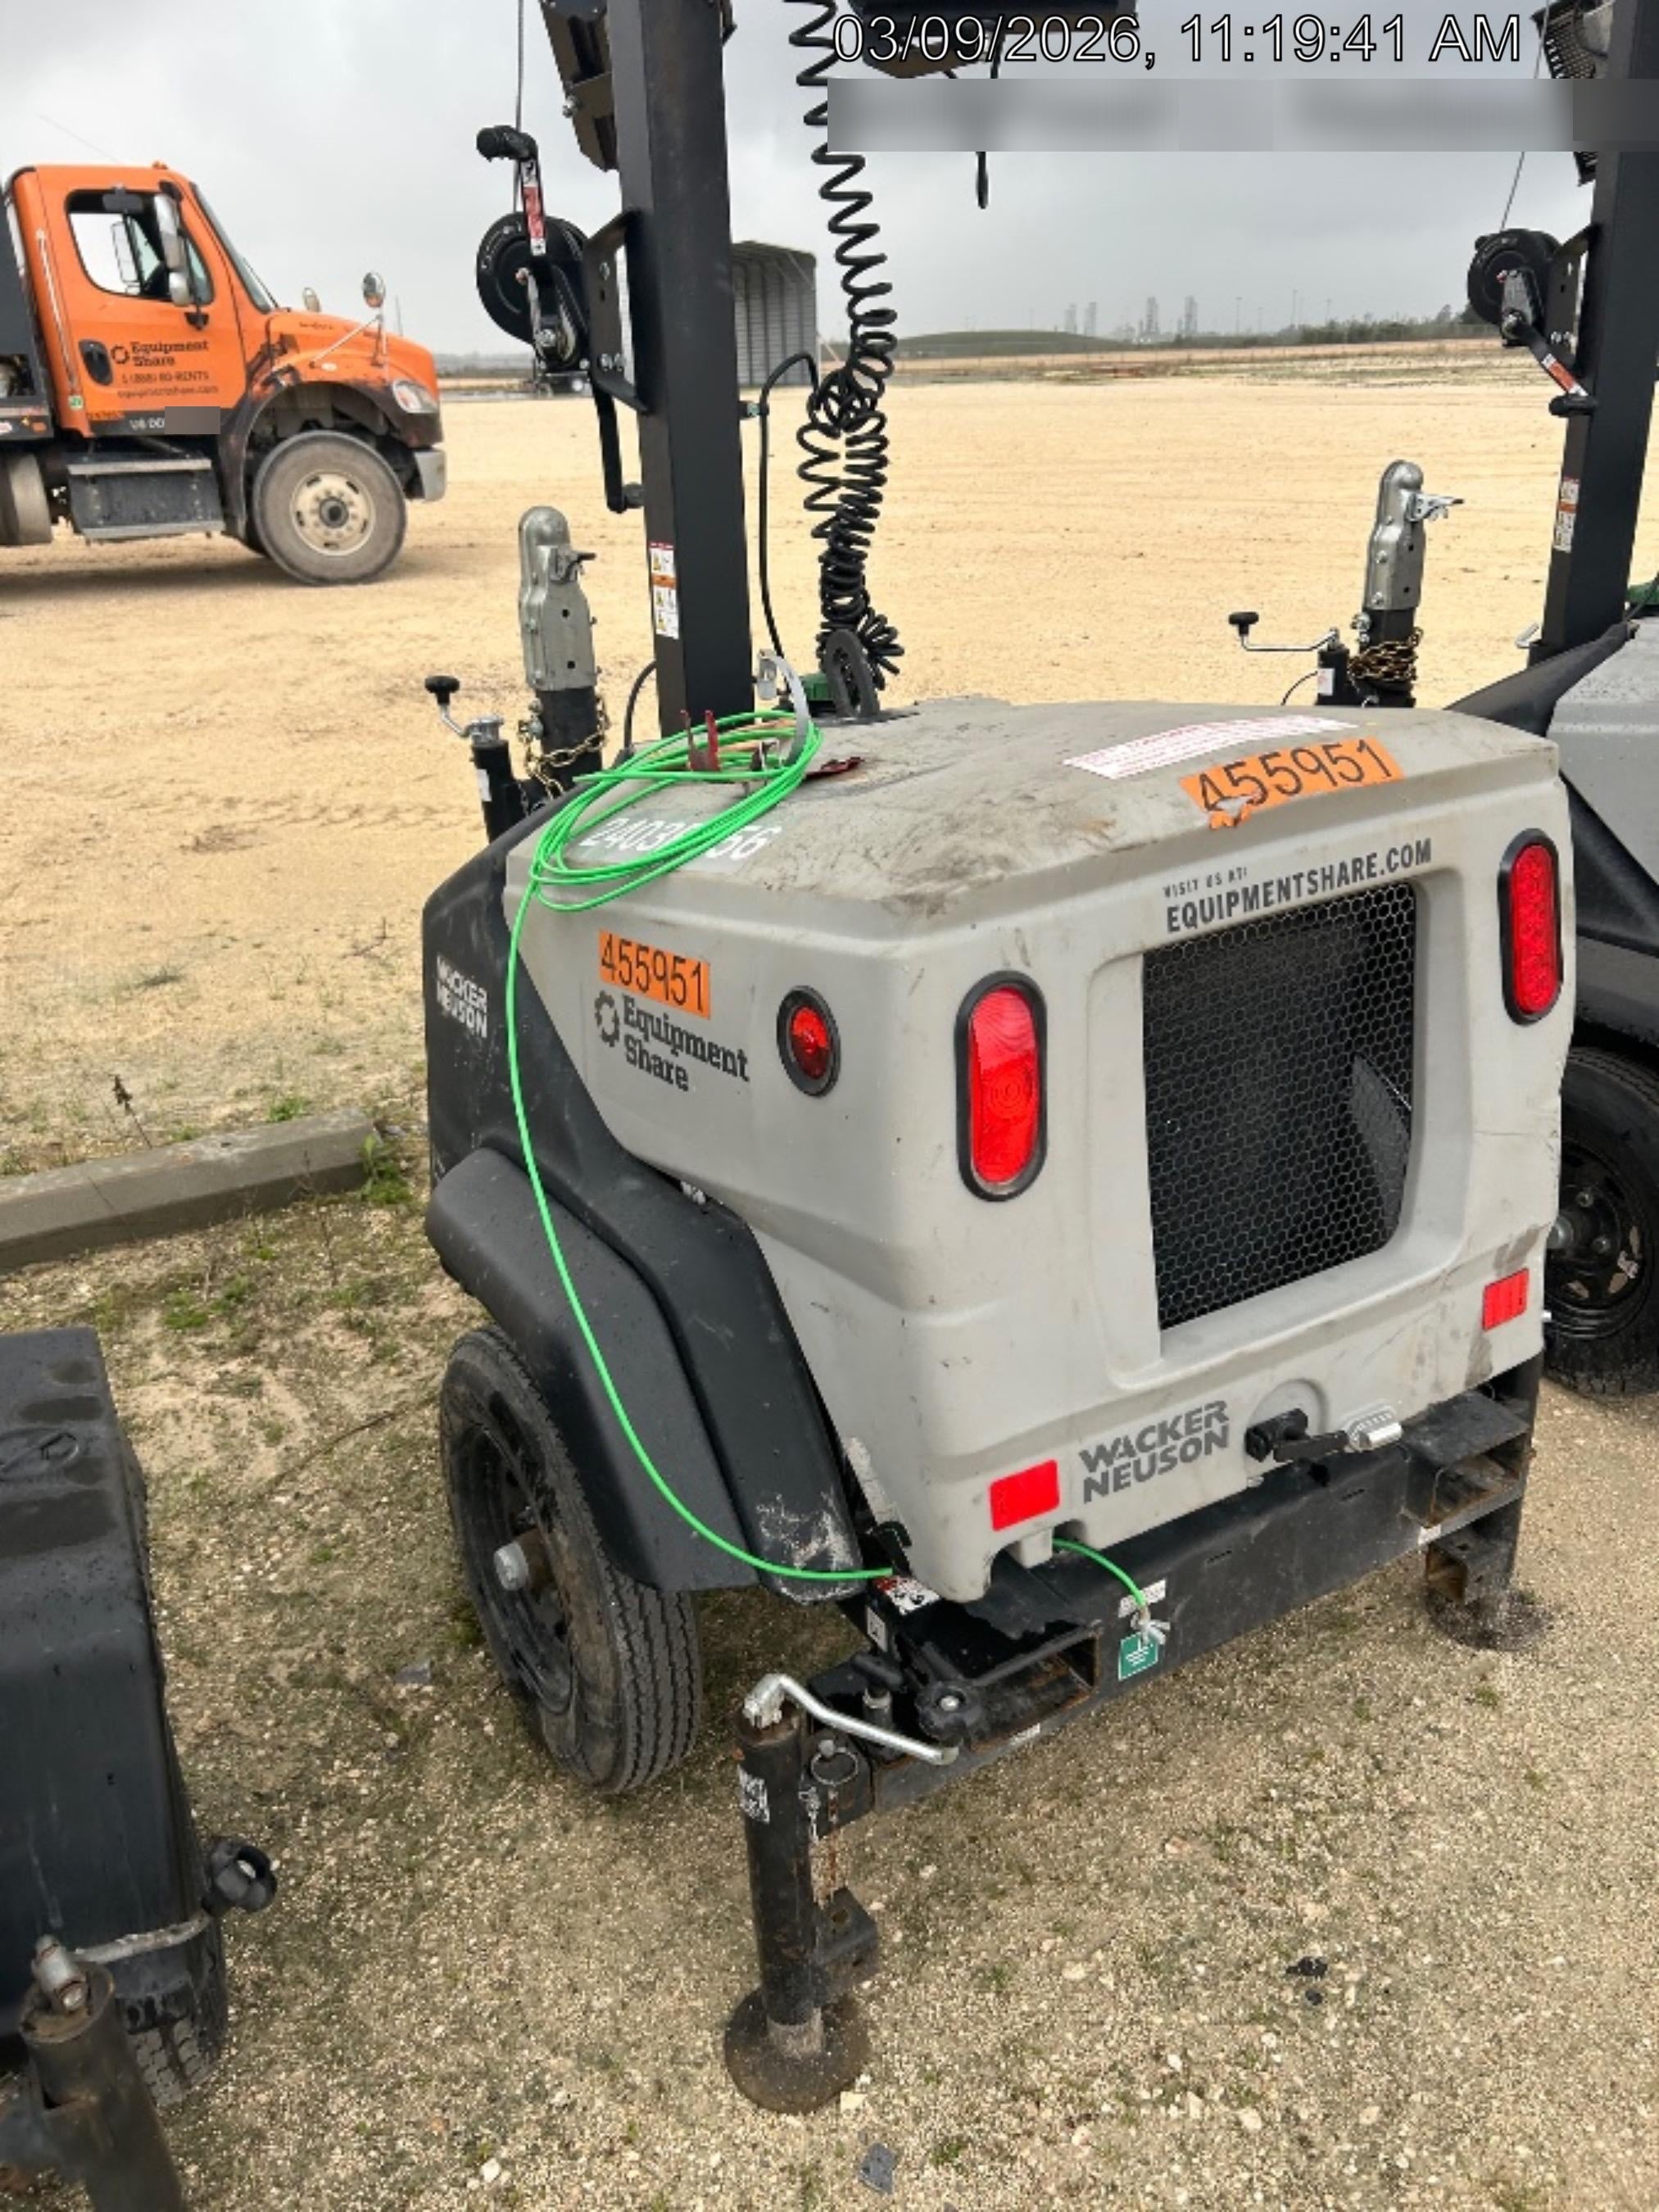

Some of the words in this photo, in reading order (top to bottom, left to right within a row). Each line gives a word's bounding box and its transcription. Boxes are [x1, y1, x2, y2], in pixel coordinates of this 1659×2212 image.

[130, 340, 209, 355] Equipment
[132, 356, 175, 367] Share
[1198, 739, 1392, 812] 455951
[1163, 878, 1199, 898] VISIT
[1205, 871, 1222, 888] US
[1167, 837, 1432, 933] EQUIPMENTSHARE.COM
[601, 933, 704, 1013] 455951
[622, 994, 750, 1082] Equipment
[623, 1034, 689, 1091] Share
[1078, 1400, 1230, 1473] WACKER
[1083, 1424, 1229, 1504] NEUSON
